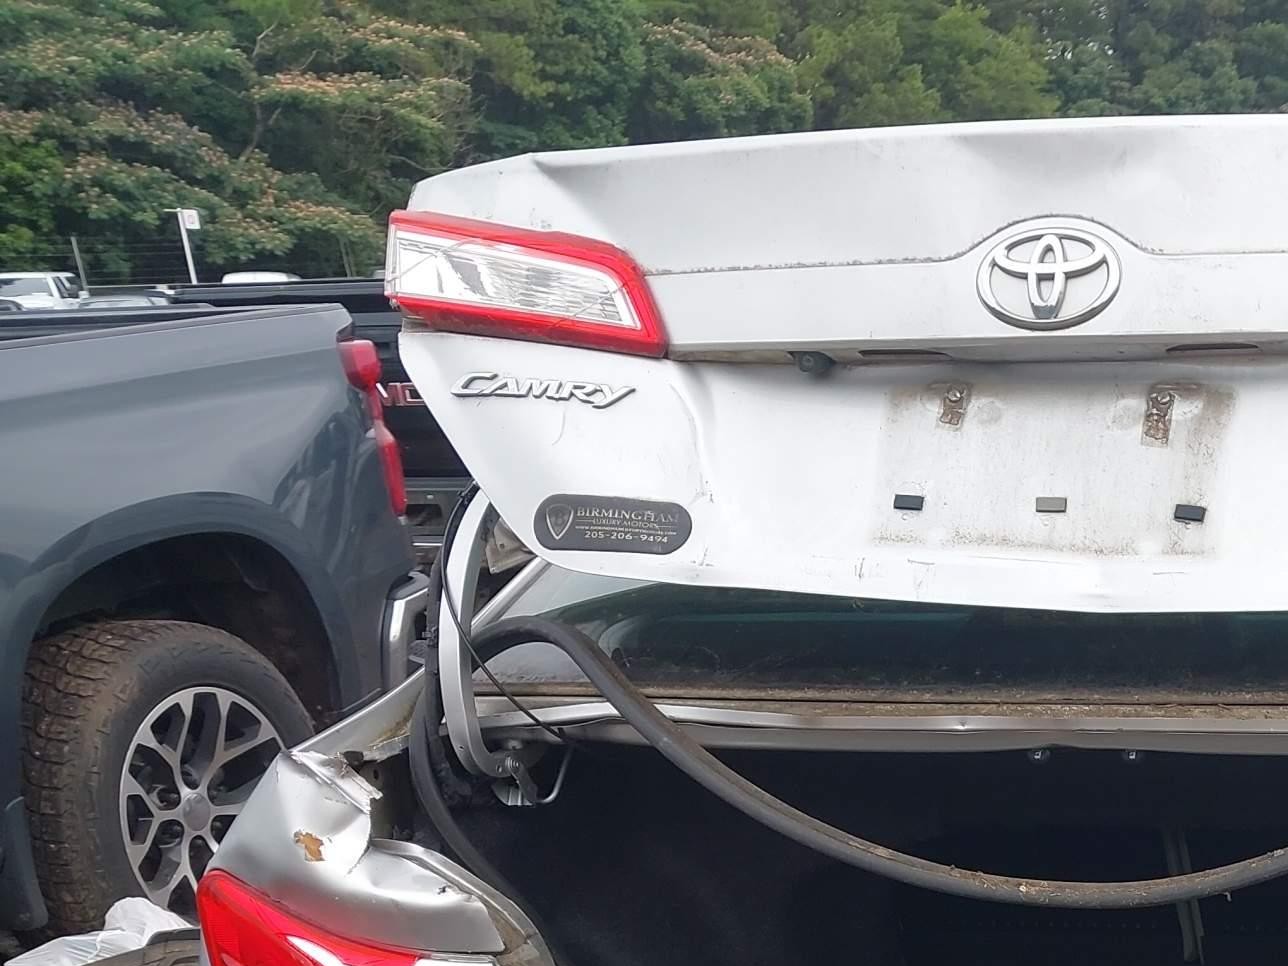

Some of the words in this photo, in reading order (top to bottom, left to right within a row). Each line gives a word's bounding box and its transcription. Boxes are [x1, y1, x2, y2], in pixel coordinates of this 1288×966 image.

[450, 372, 636, 409] CAMRY
[576, 506, 679, 522] BIRMINGHAM
[585, 530, 668, 543] 205-206-9494
